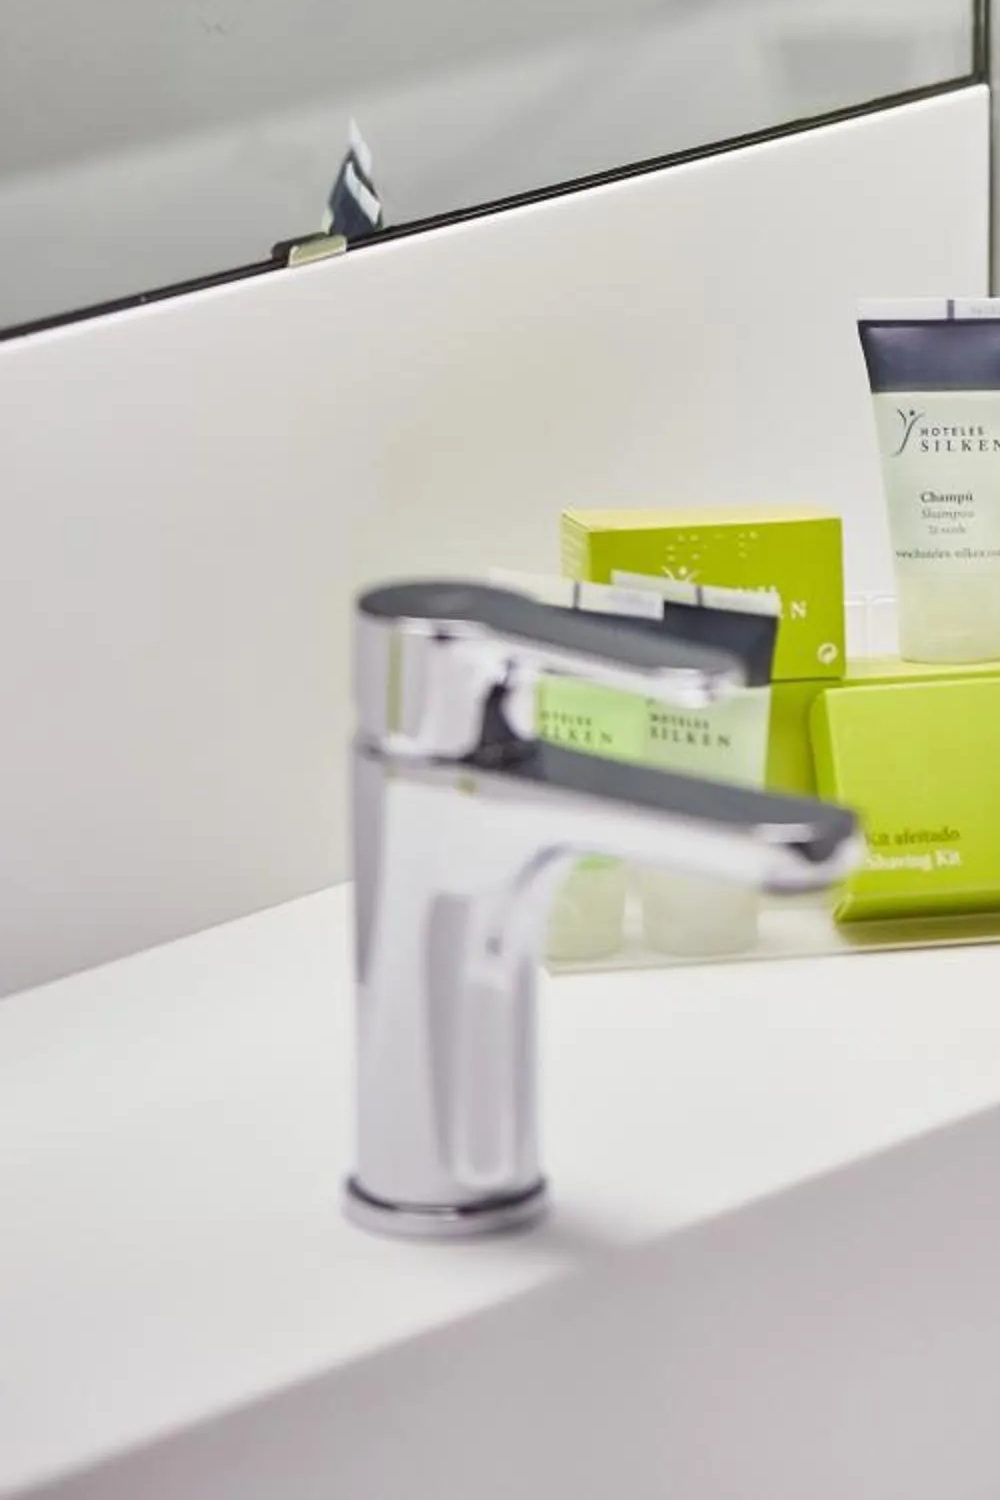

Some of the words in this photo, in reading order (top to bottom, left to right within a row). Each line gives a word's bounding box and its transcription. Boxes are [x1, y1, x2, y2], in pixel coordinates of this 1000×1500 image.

[919, 425, 985, 437] HOTELES
[919, 489, 974, 505] Champú
[920, 507, 975, 520] Shampoo
[649, 724, 732, 748] SILKEN
[936, 849, 962, 867] Kit
